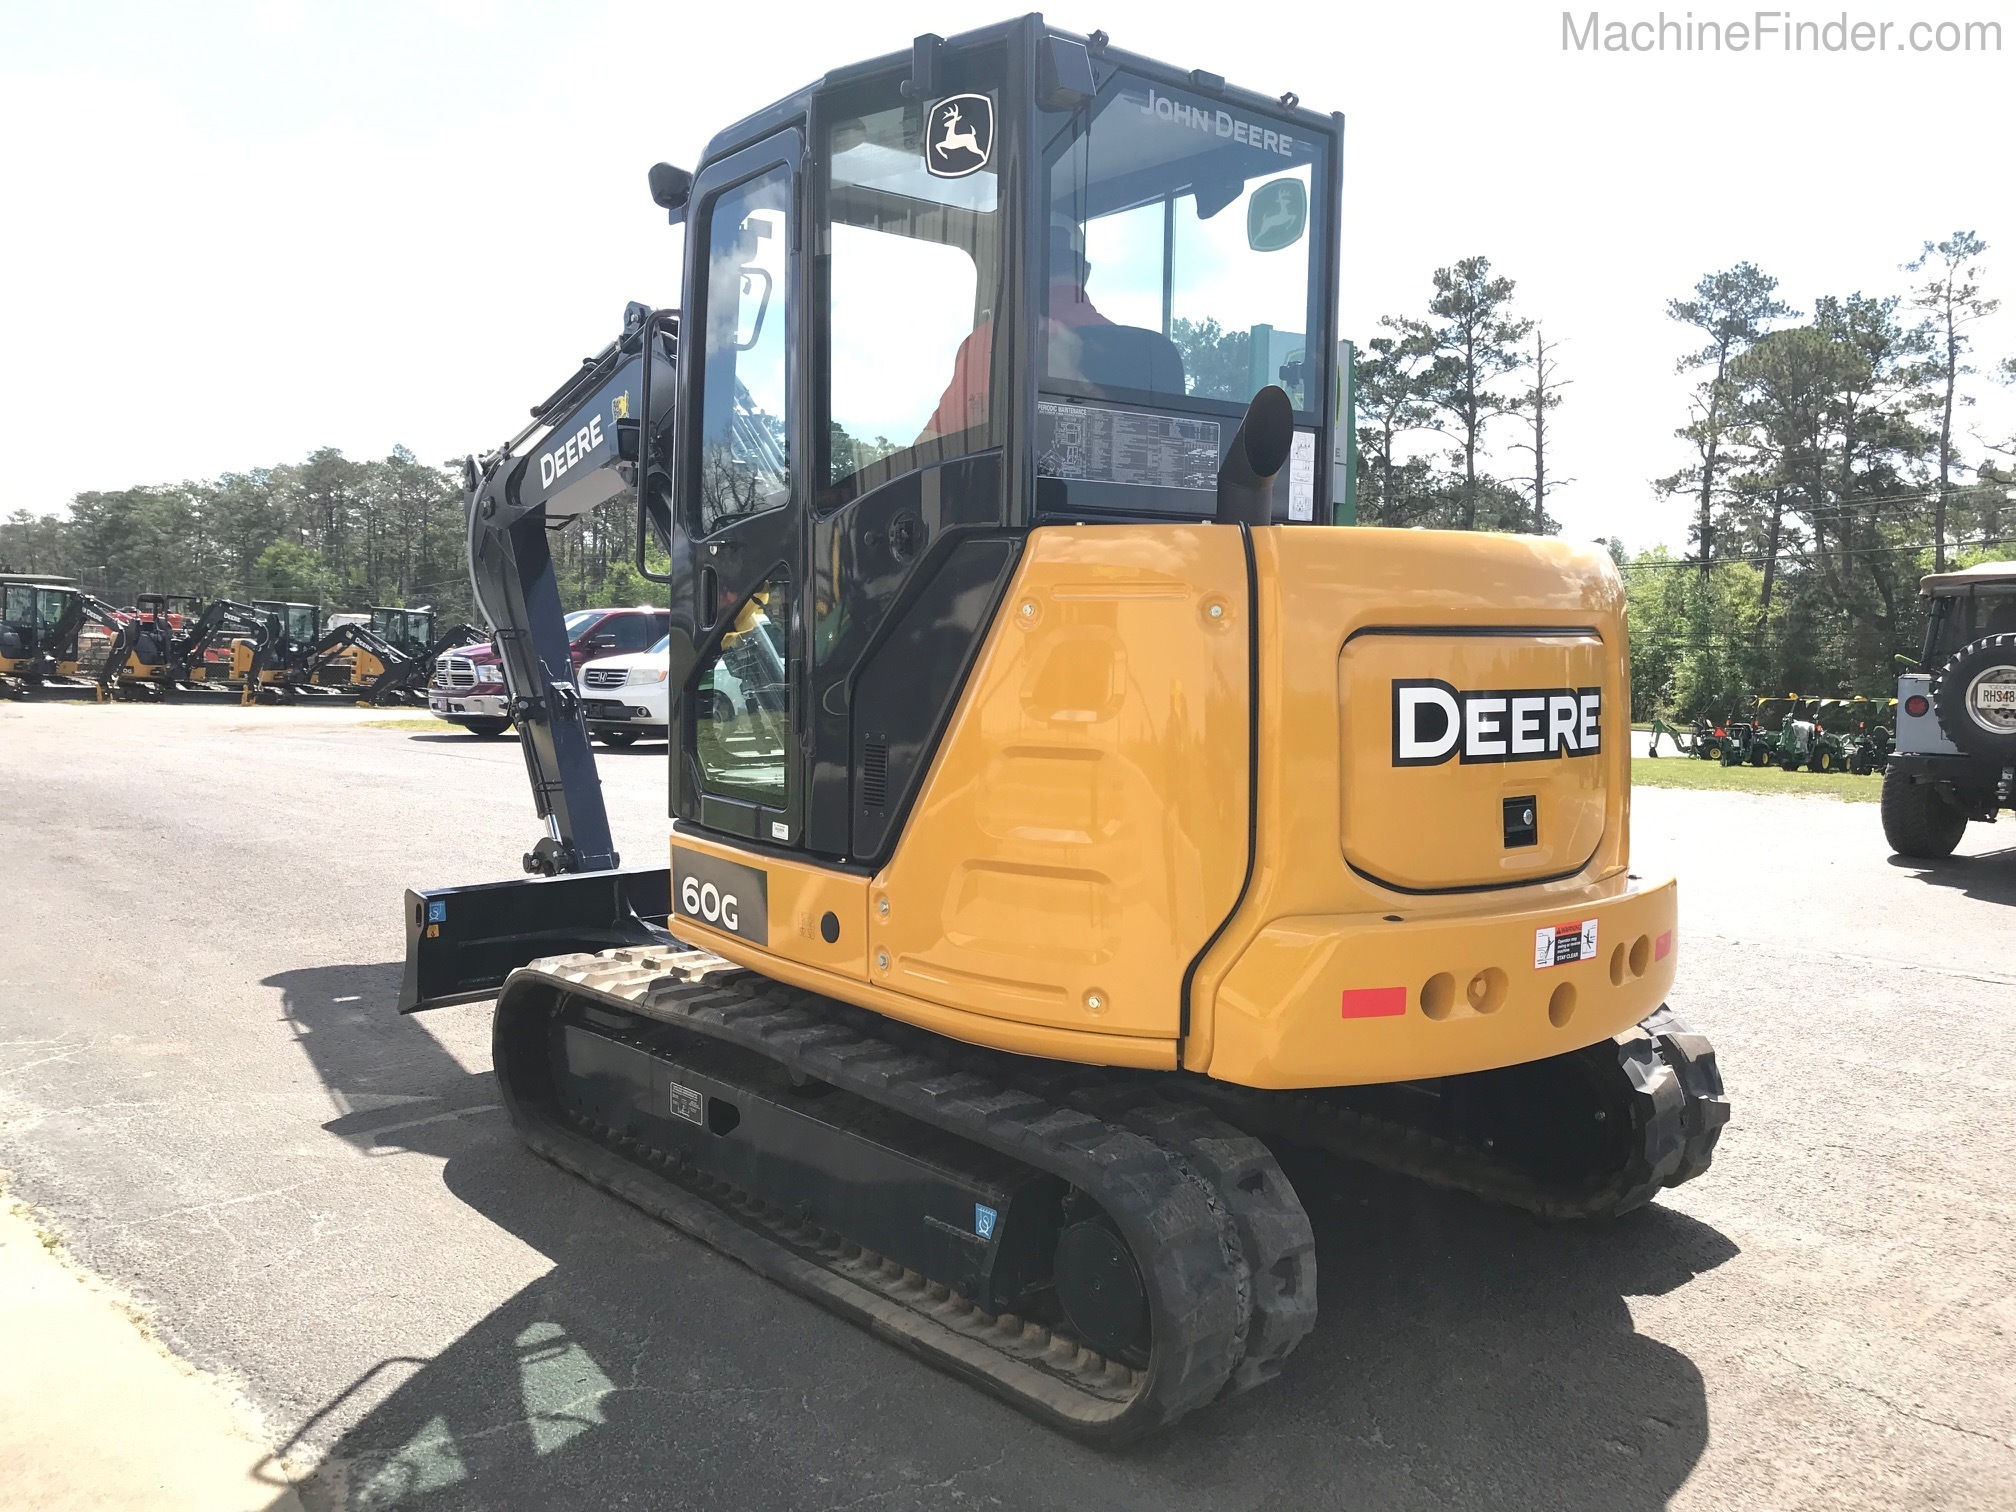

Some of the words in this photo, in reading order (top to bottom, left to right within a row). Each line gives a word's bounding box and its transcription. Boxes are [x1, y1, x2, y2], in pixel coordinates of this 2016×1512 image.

[1141, 89, 1208, 132] JOHN
[1215, 110, 1292, 157] DEERE
[1038, 404, 1057, 412] PERIODIC
[1058, 406, 1087, 415] MAINTENANCE
[540, 414, 604, 490] DEERE
[355, 637, 373, 652] DEERE
[1399, 687, 1599, 758] DEERE
[682, 876, 738, 930] 60G
[1561, 924, 1582, 934] WARNING
[1566, 952, 1579, 960] CLEAR
